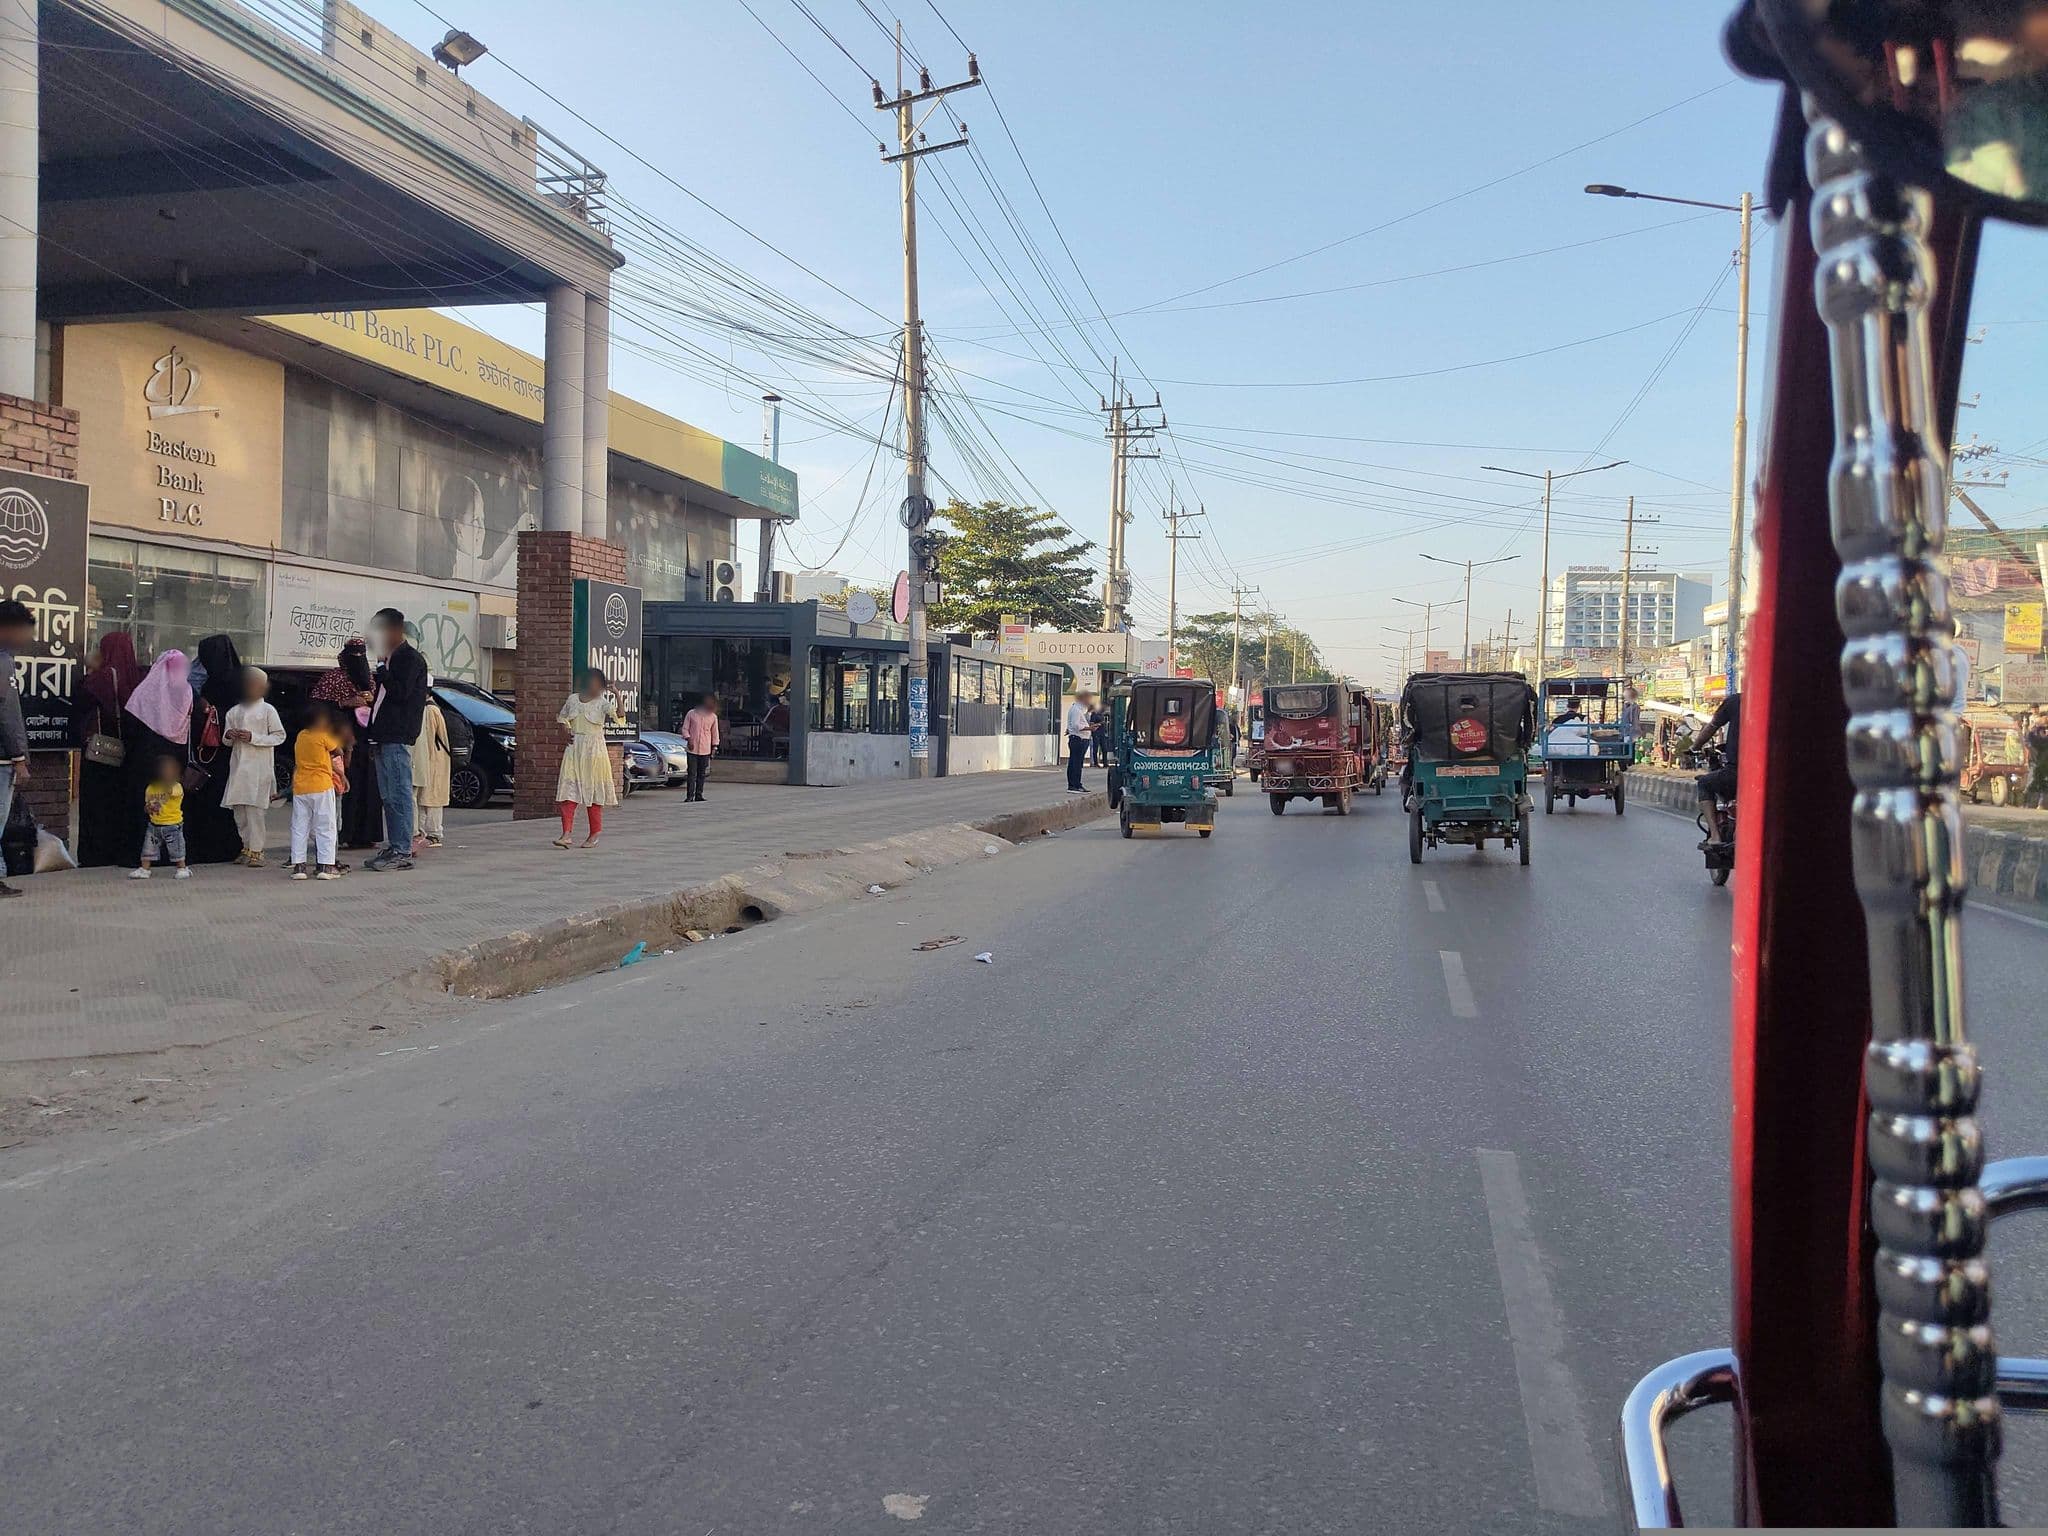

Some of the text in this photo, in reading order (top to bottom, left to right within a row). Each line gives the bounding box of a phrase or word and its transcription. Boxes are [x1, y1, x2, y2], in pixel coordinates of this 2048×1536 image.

[364, 310, 417, 356] Bank
[422, 332, 468, 375] PLC.
[147, 430, 217, 466] Eastern
[157, 465, 205, 495] Bank
[290, 606, 328, 632] বিশ্বাসে
[329, 616, 356, 633] হোক
[299, 630, 328, 649] সহজ
[1048, 643, 1115, 654] OUTLOOK
[592, 645, 639, 683] Niribili
